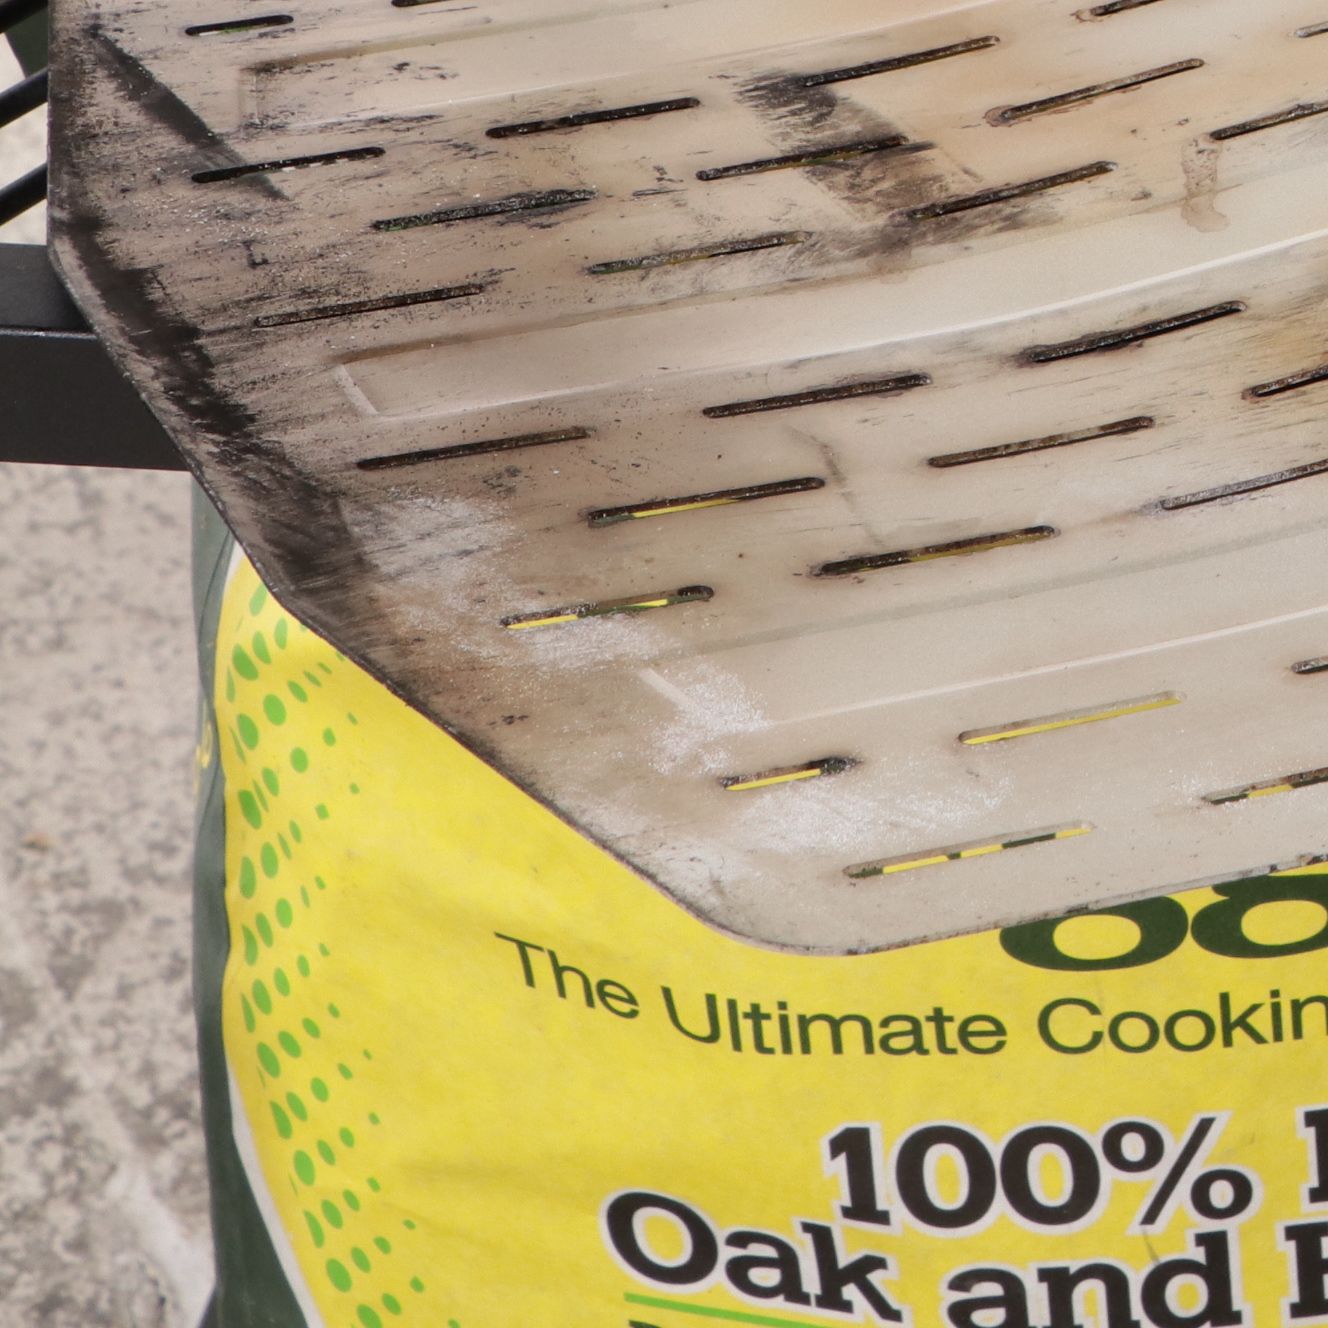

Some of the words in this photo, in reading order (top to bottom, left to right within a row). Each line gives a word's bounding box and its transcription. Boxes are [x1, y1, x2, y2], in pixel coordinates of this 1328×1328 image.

[493, 930, 639, 1020] The
[660, 985, 1008, 1056] Ultimate
[828, 1116, 1254, 1229] 100%
[606, 1190, 902, 1322] Oak
[945, 1229, 1243, 1328] and
